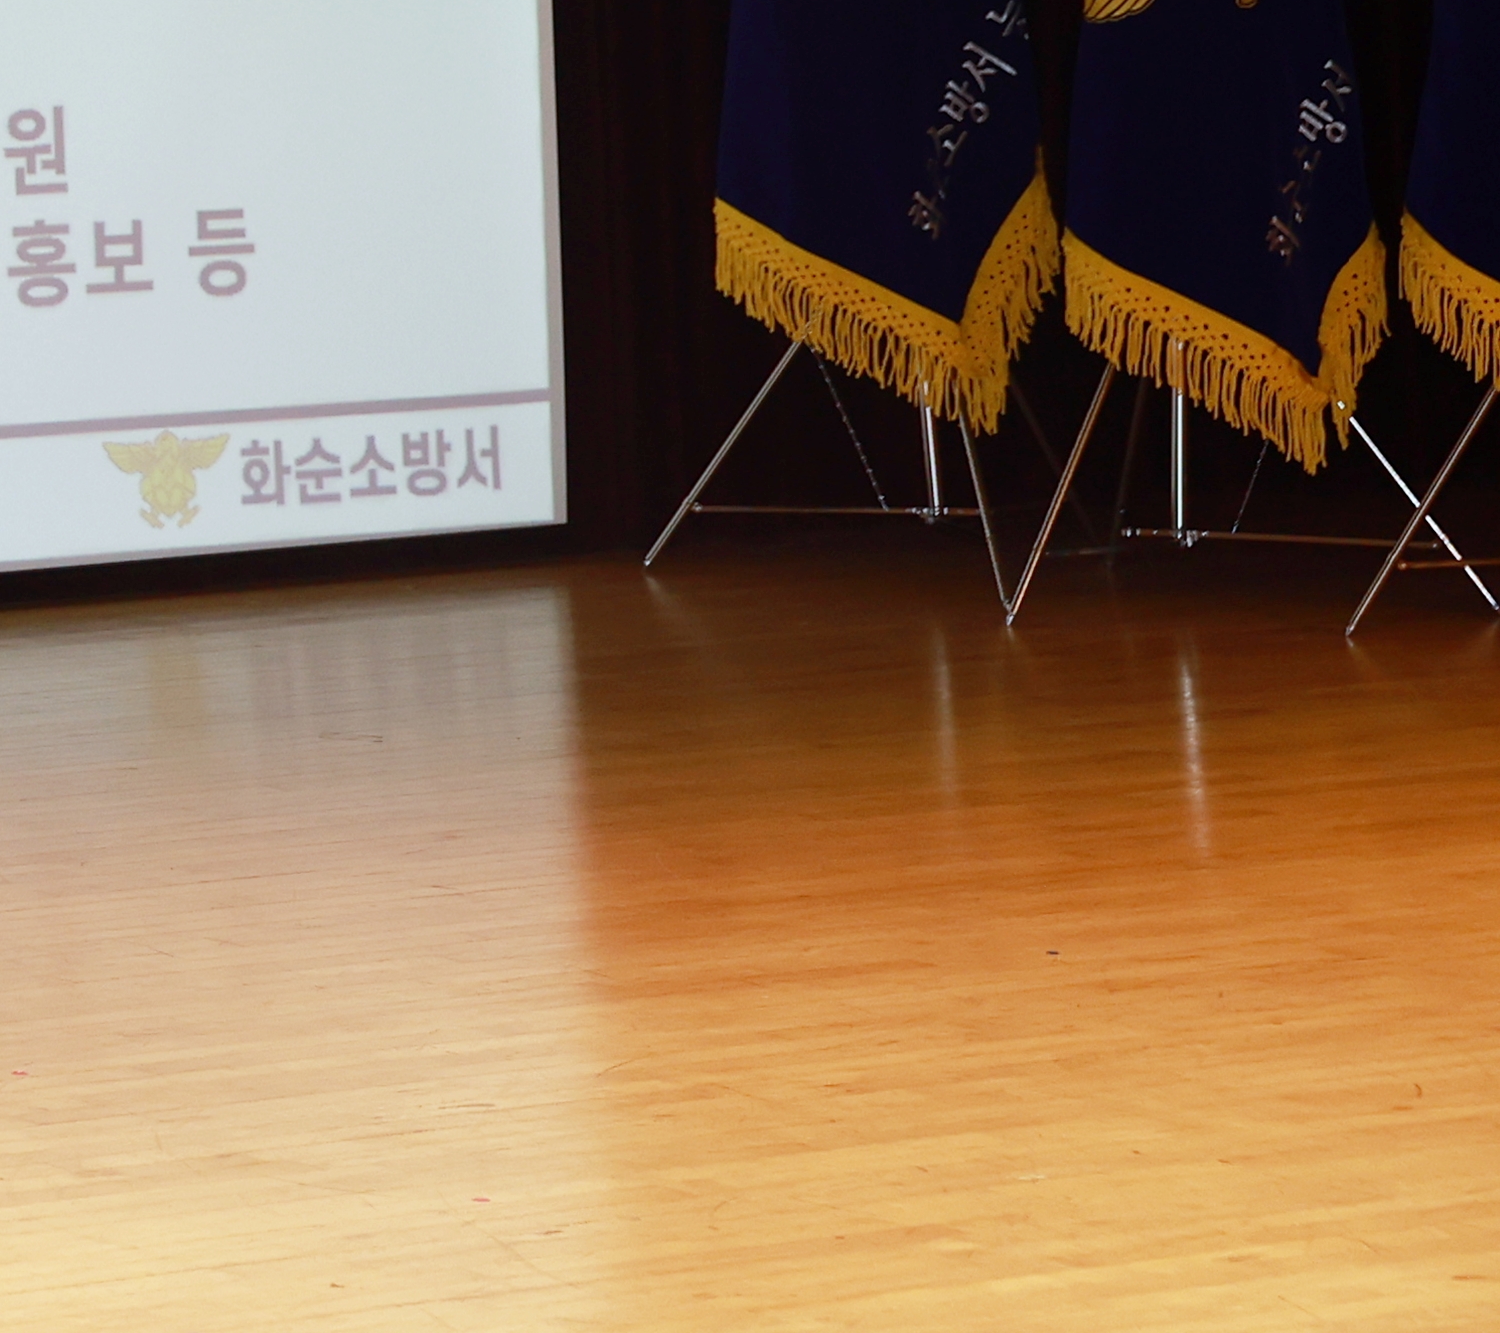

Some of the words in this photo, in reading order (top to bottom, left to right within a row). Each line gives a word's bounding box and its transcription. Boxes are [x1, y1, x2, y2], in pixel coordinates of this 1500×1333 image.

[7, 219, 154, 308] 홍보
[188, 208, 256, 297] 등
[240, 424, 502, 506] 화순소방서
